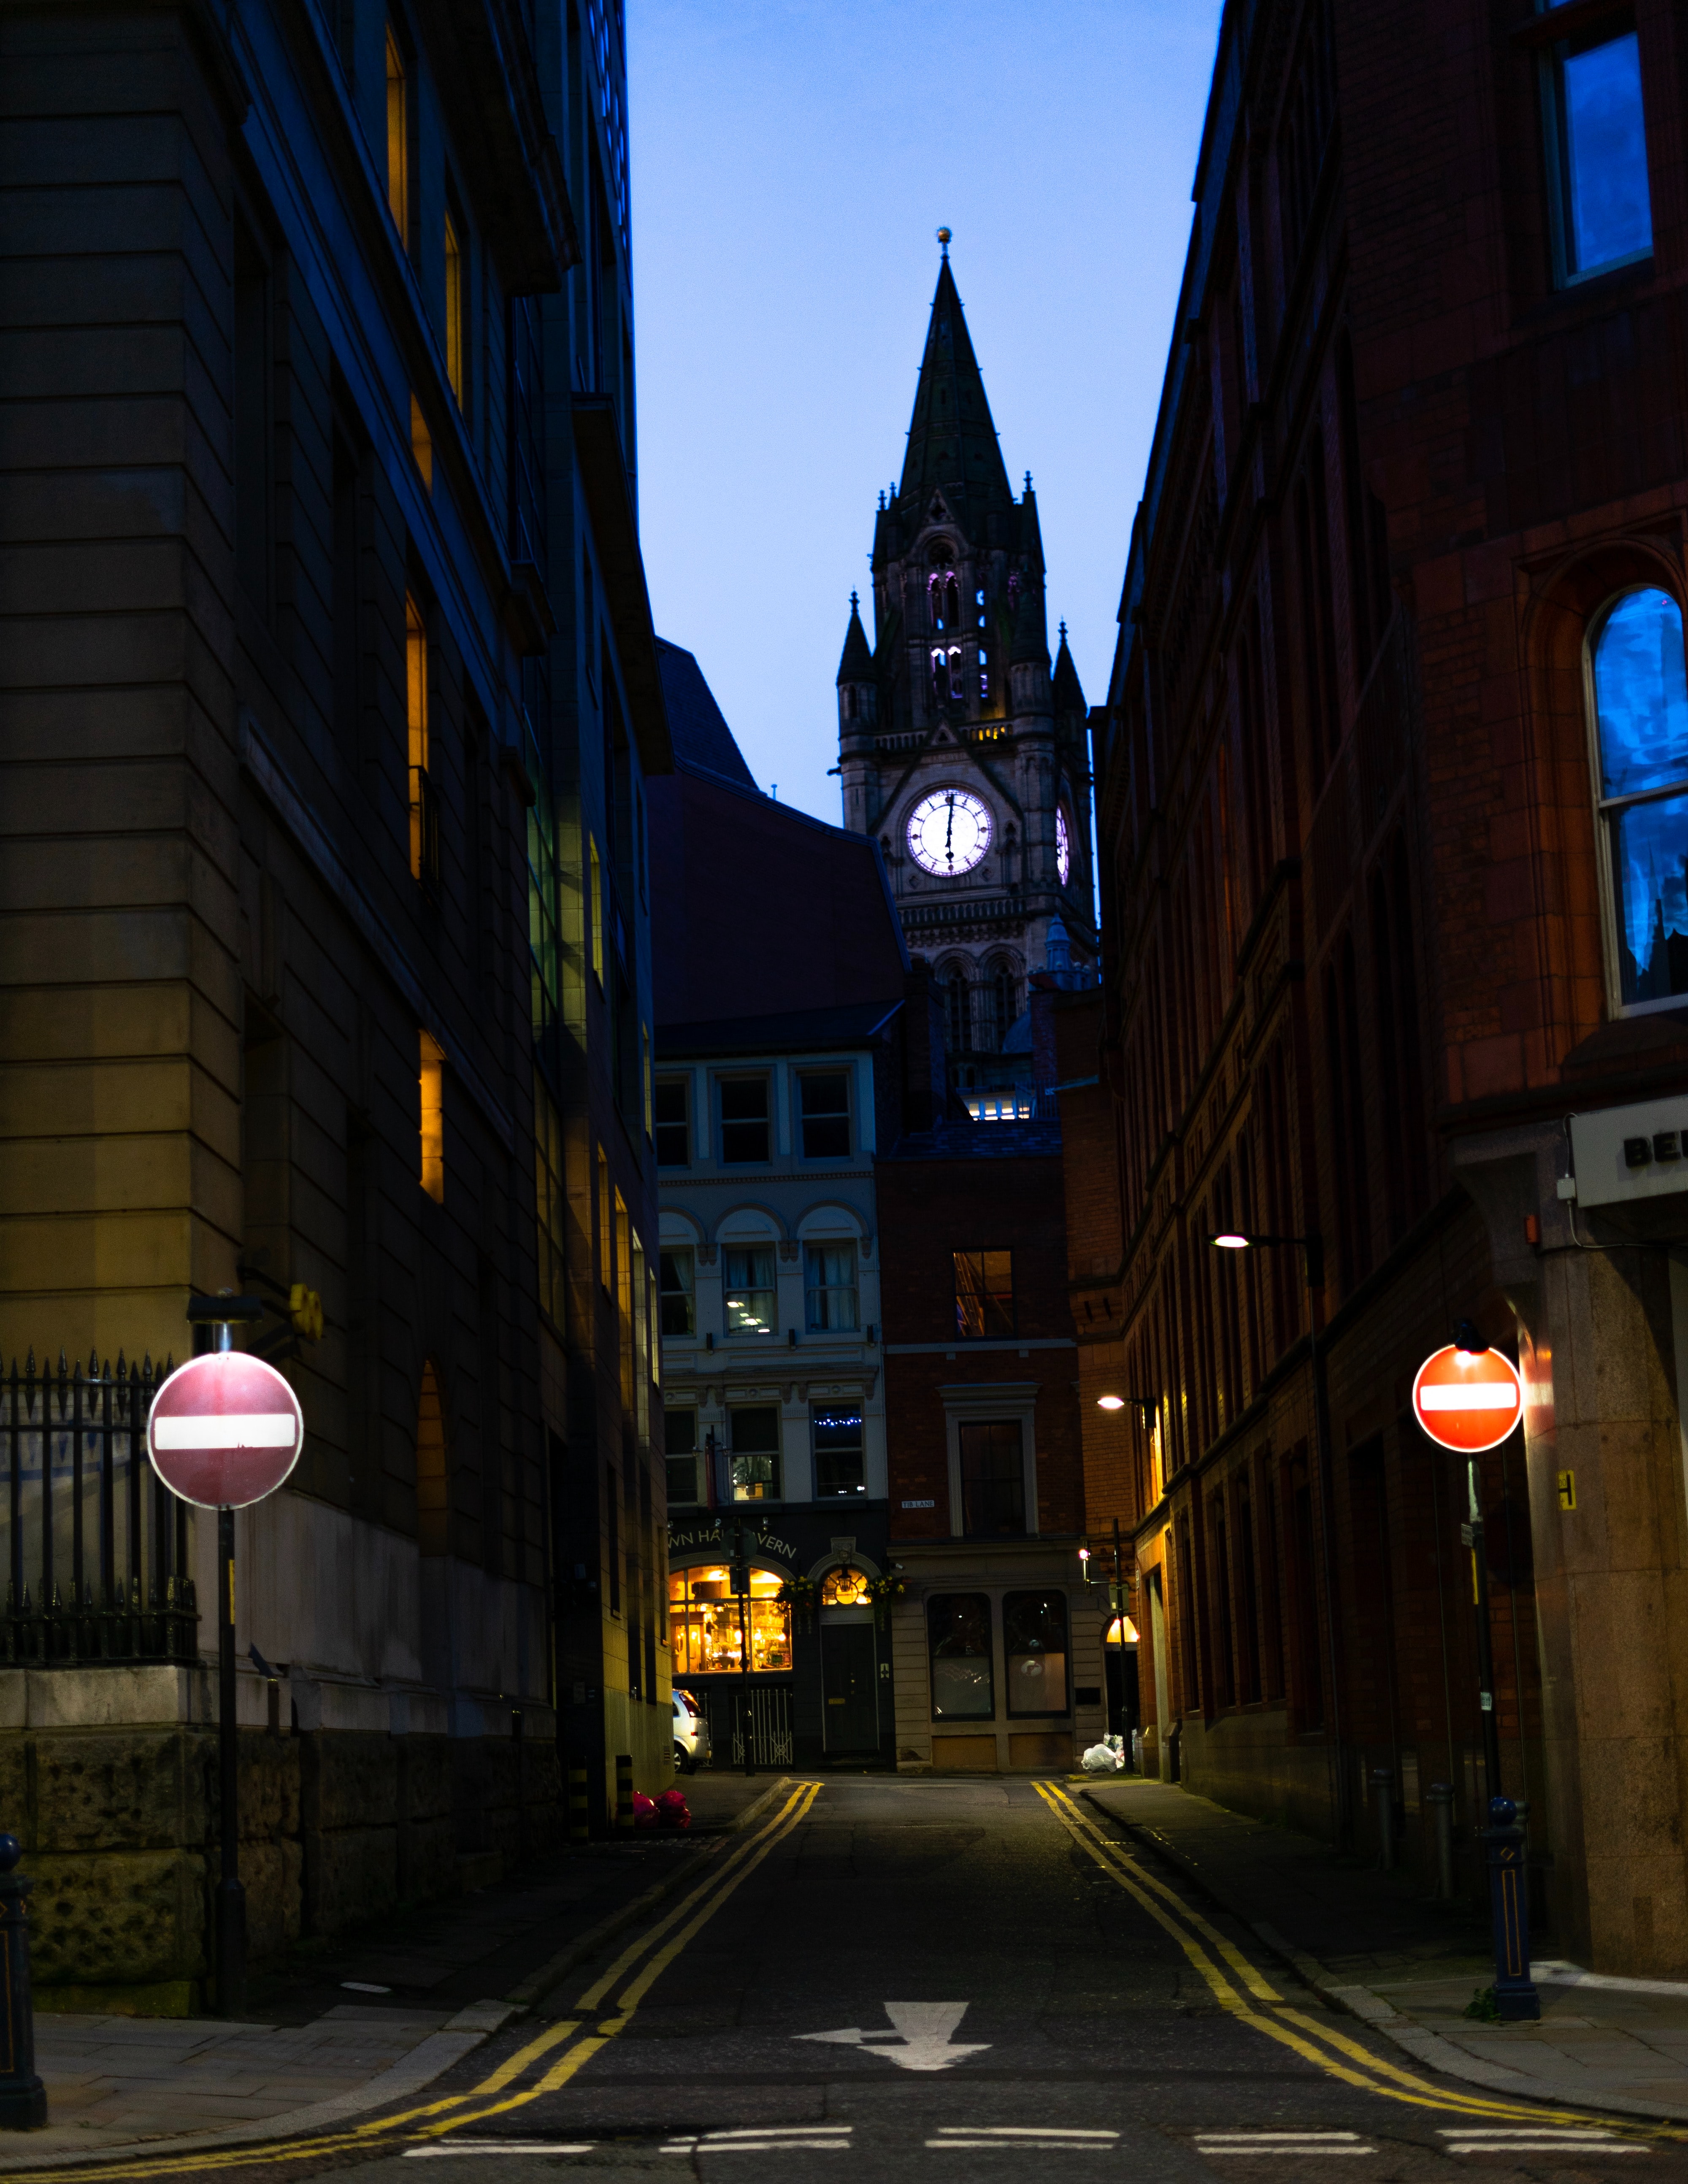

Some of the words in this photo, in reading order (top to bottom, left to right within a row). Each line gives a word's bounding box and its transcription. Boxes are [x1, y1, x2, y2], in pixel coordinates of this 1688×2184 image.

[668, 1533, 693, 1549] WN
[698, 1529, 724, 1542] HA
[753, 1532, 797, 1559] VERN
